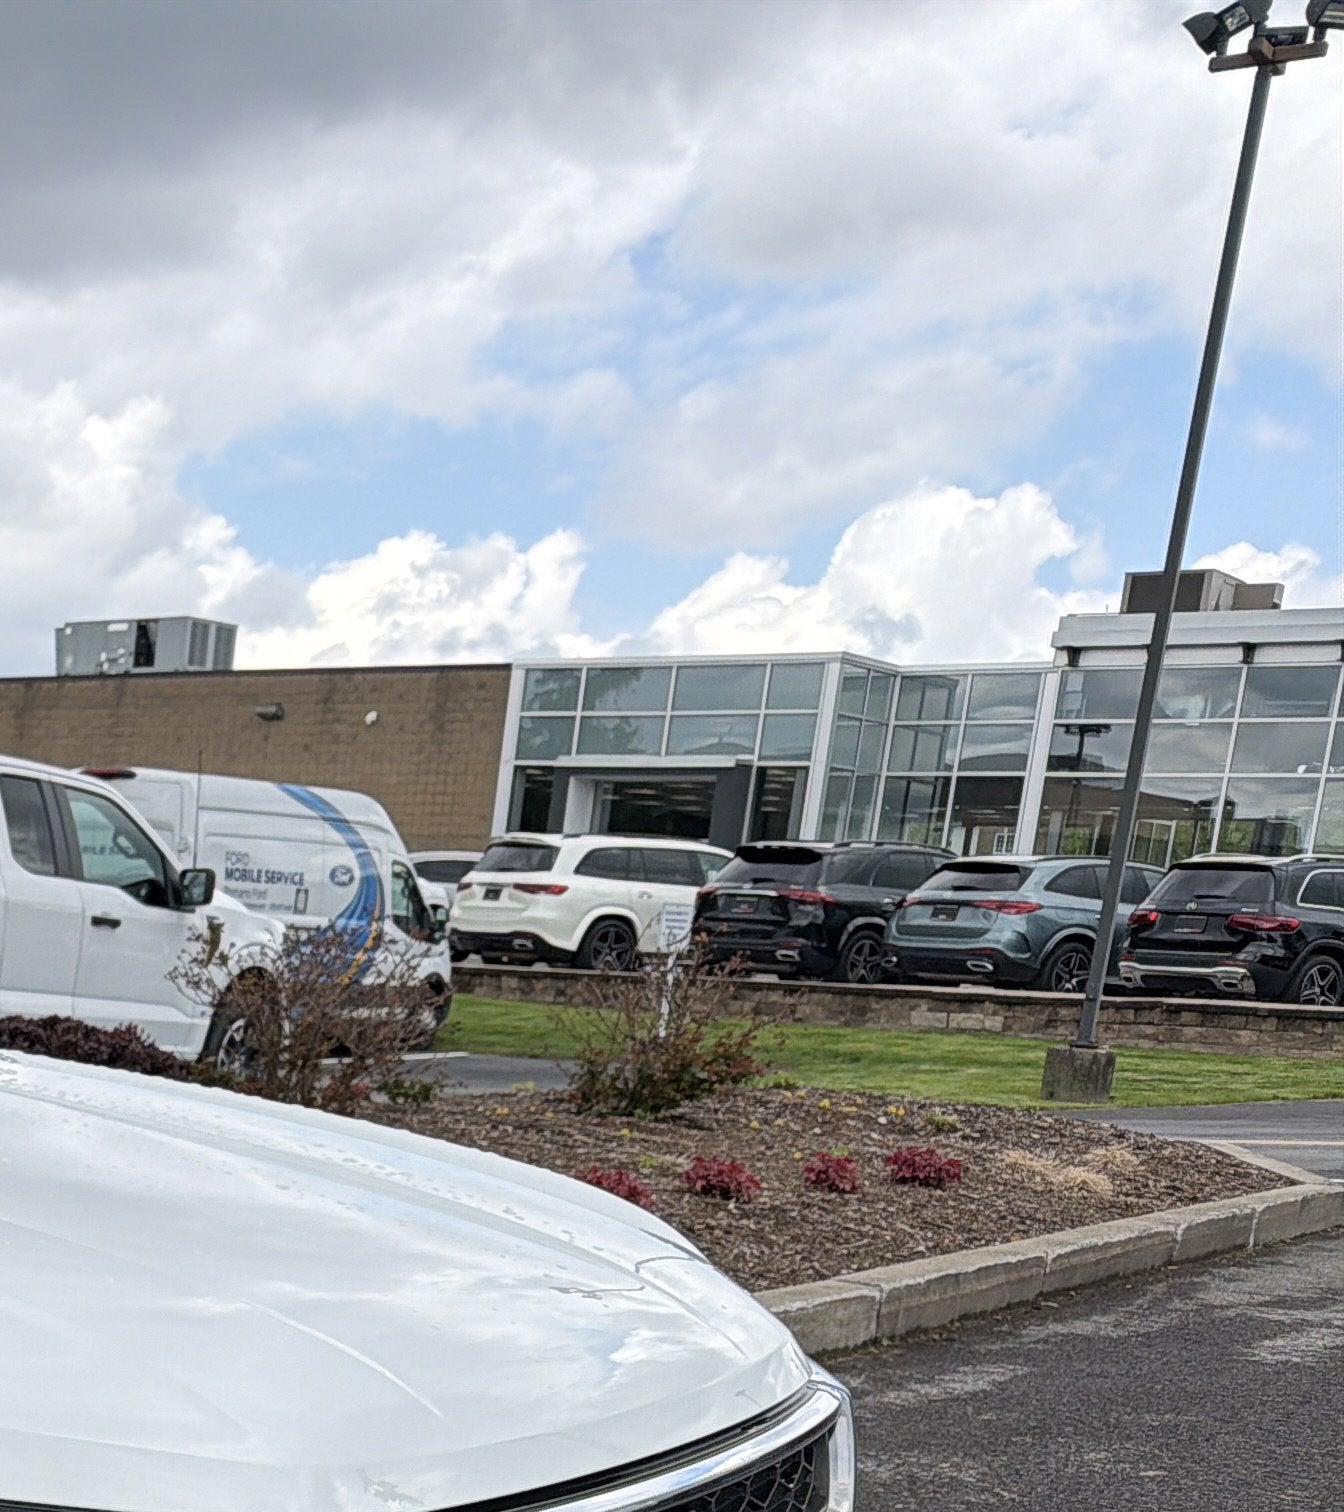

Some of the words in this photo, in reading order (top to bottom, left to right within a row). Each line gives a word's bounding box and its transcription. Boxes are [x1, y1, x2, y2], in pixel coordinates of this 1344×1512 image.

[224, 850, 250, 866] FORD
[224, 866, 263, 883] MOBILE
[264, 870, 305, 886] SERVICE
